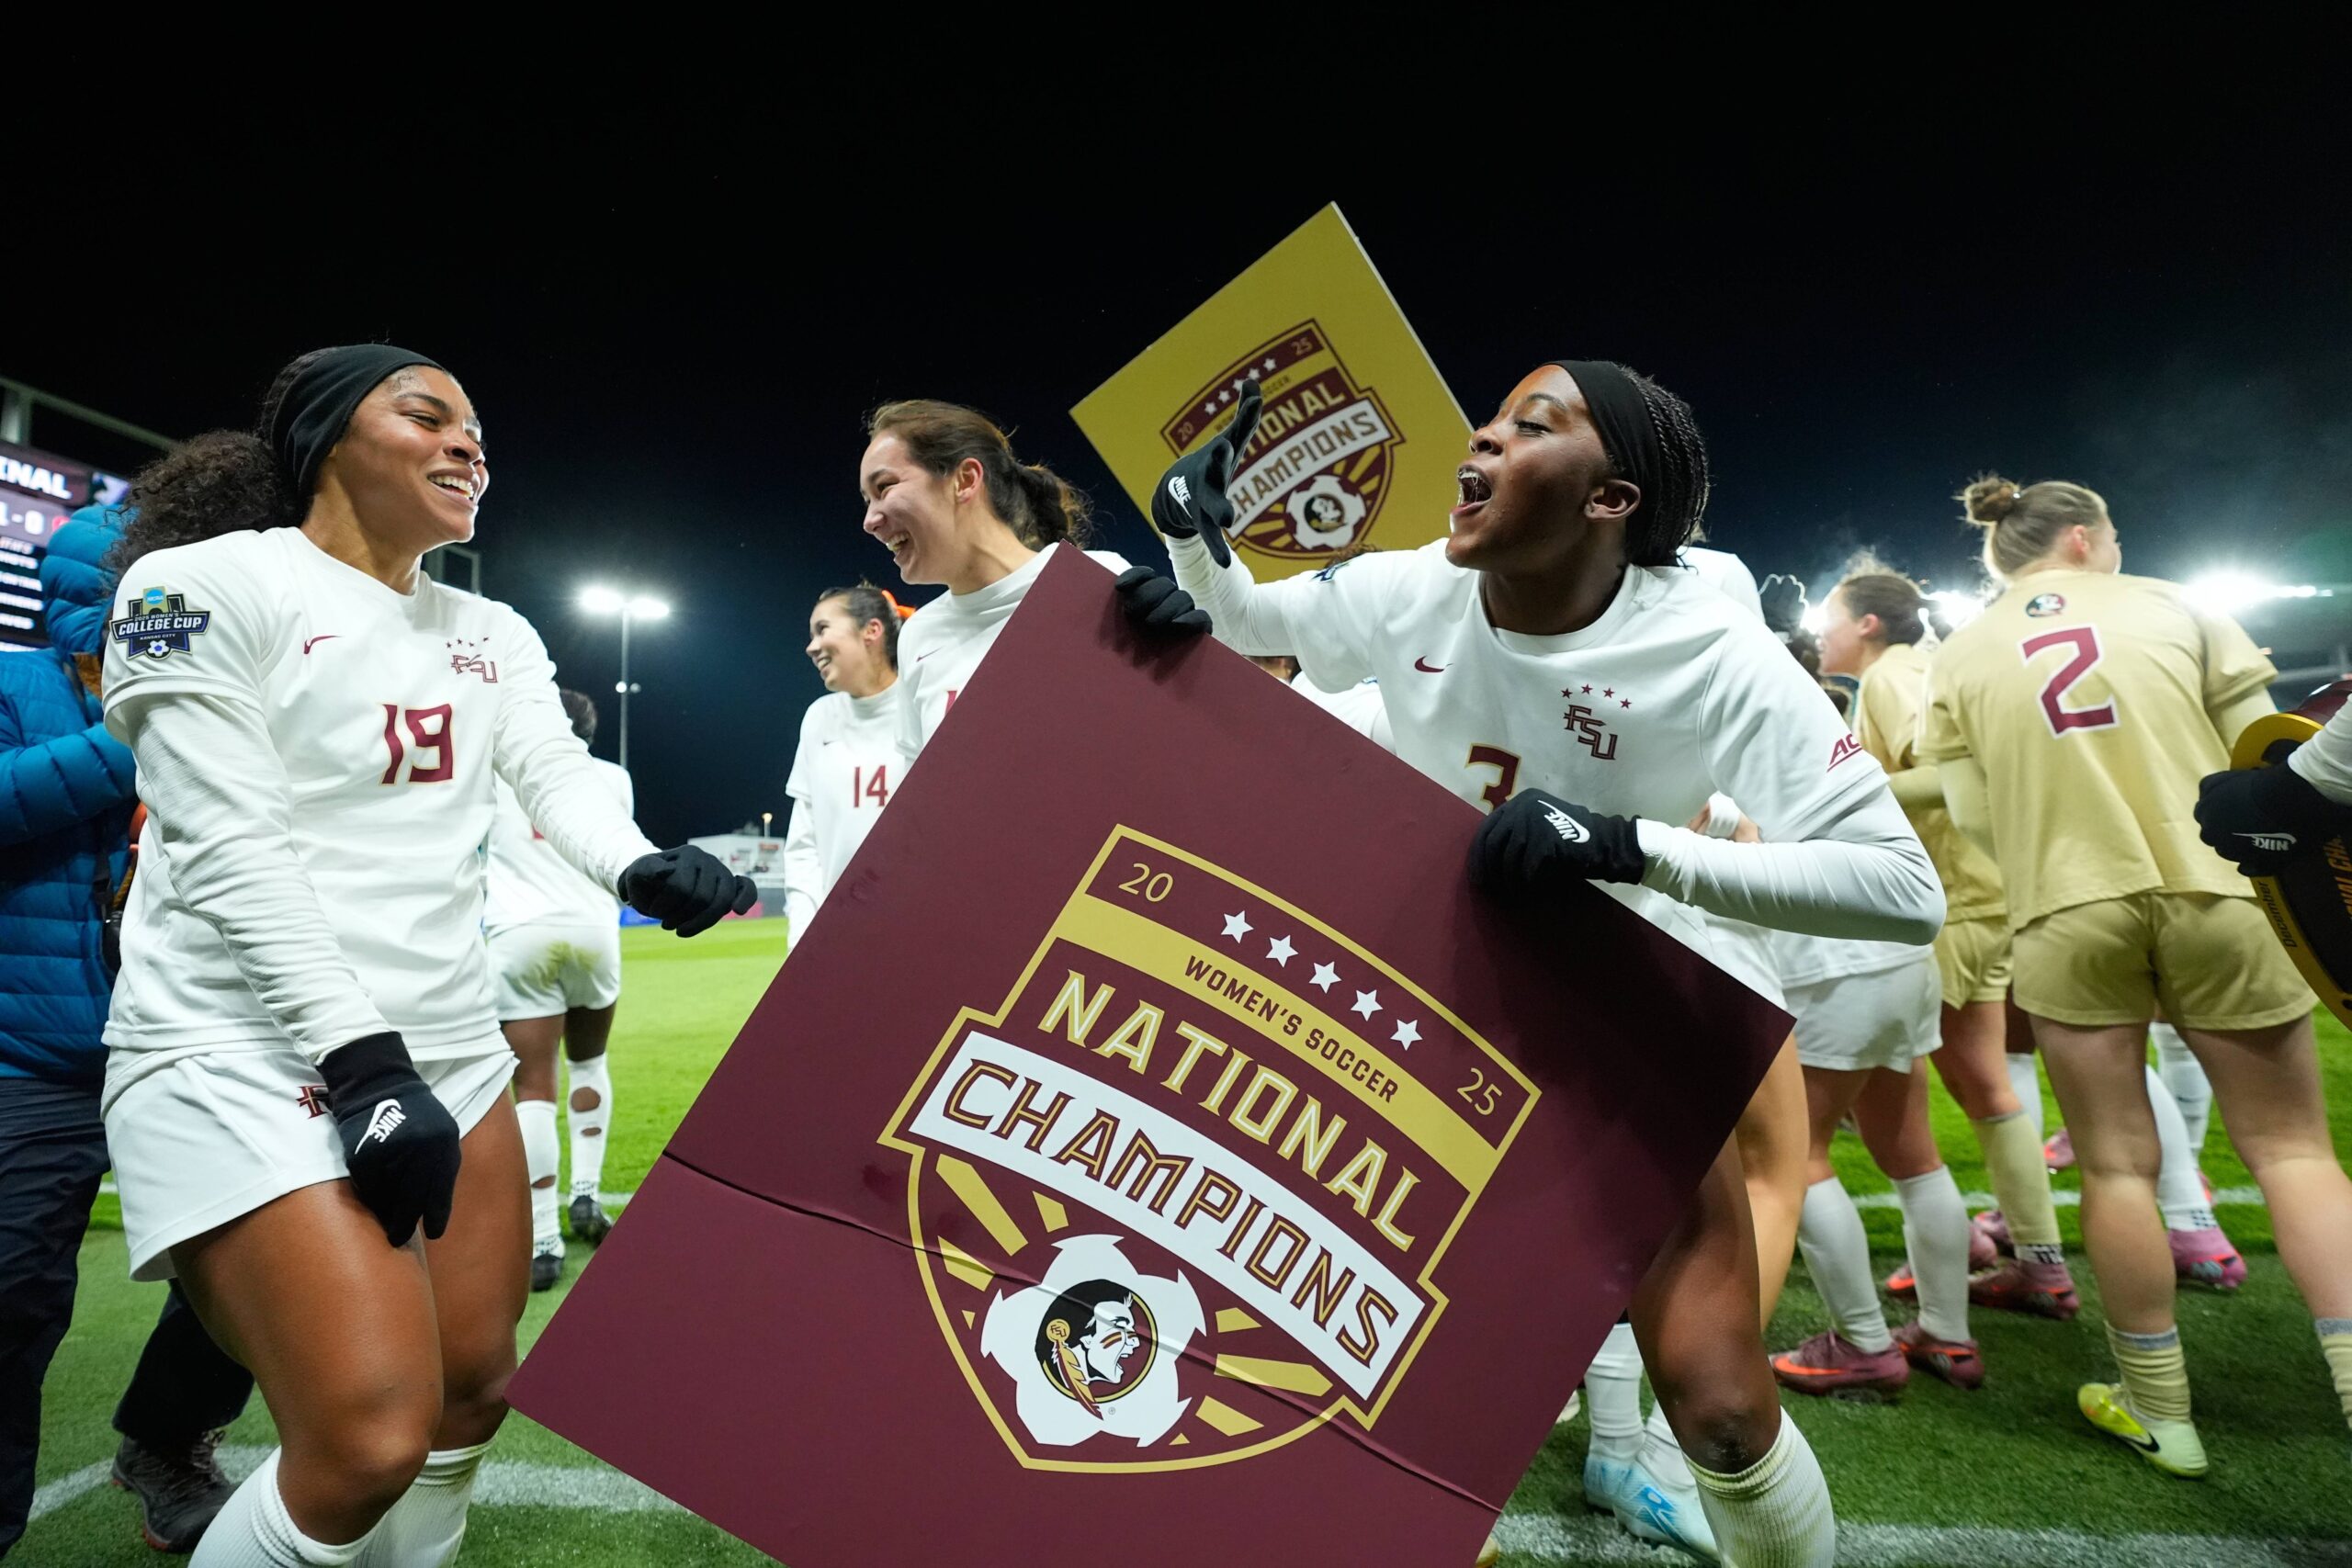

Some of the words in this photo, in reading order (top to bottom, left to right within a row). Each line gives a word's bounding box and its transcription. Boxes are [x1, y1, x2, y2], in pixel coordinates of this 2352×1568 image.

[1291, 337, 1313, 355] 25
[1177, 422, 1194, 442] 20
[1245, 382, 1346, 456] TIONAL
[0, 457, 72, 500] INAL
[1233, 411, 1378, 523] HAMPIONS
[1174, 475, 1192, 503] NIKE
[119, 617, 172, 636] COLLEGE
[174, 616, 202, 629] CUP
[2019, 625, 2117, 738] 2
[379, 703, 454, 785] 19
[1564, 705, 1618, 761] FSU
[1828, 733, 1860, 766] AC
[854, 765, 888, 808] 14
[1464, 743, 1521, 811] 3
[1544, 811, 1578, 840] NIKE
[2252, 836, 2290, 852] NIKE
[1118, 863, 1174, 902] 20
[2258, 881, 2298, 948] December
[1184, 955, 1302, 1036] WOMEN'S
[1305, 1028, 1399, 1103] SOCCER
[1037, 968, 1421, 1252] NATIONAL
[1456, 1067, 1503, 1116] 25
[368, 1107, 406, 1143] NIKE
[943, 1058, 1399, 1368] CHAMPIONS
[1050, 1324, 1067, 1337] FSU
